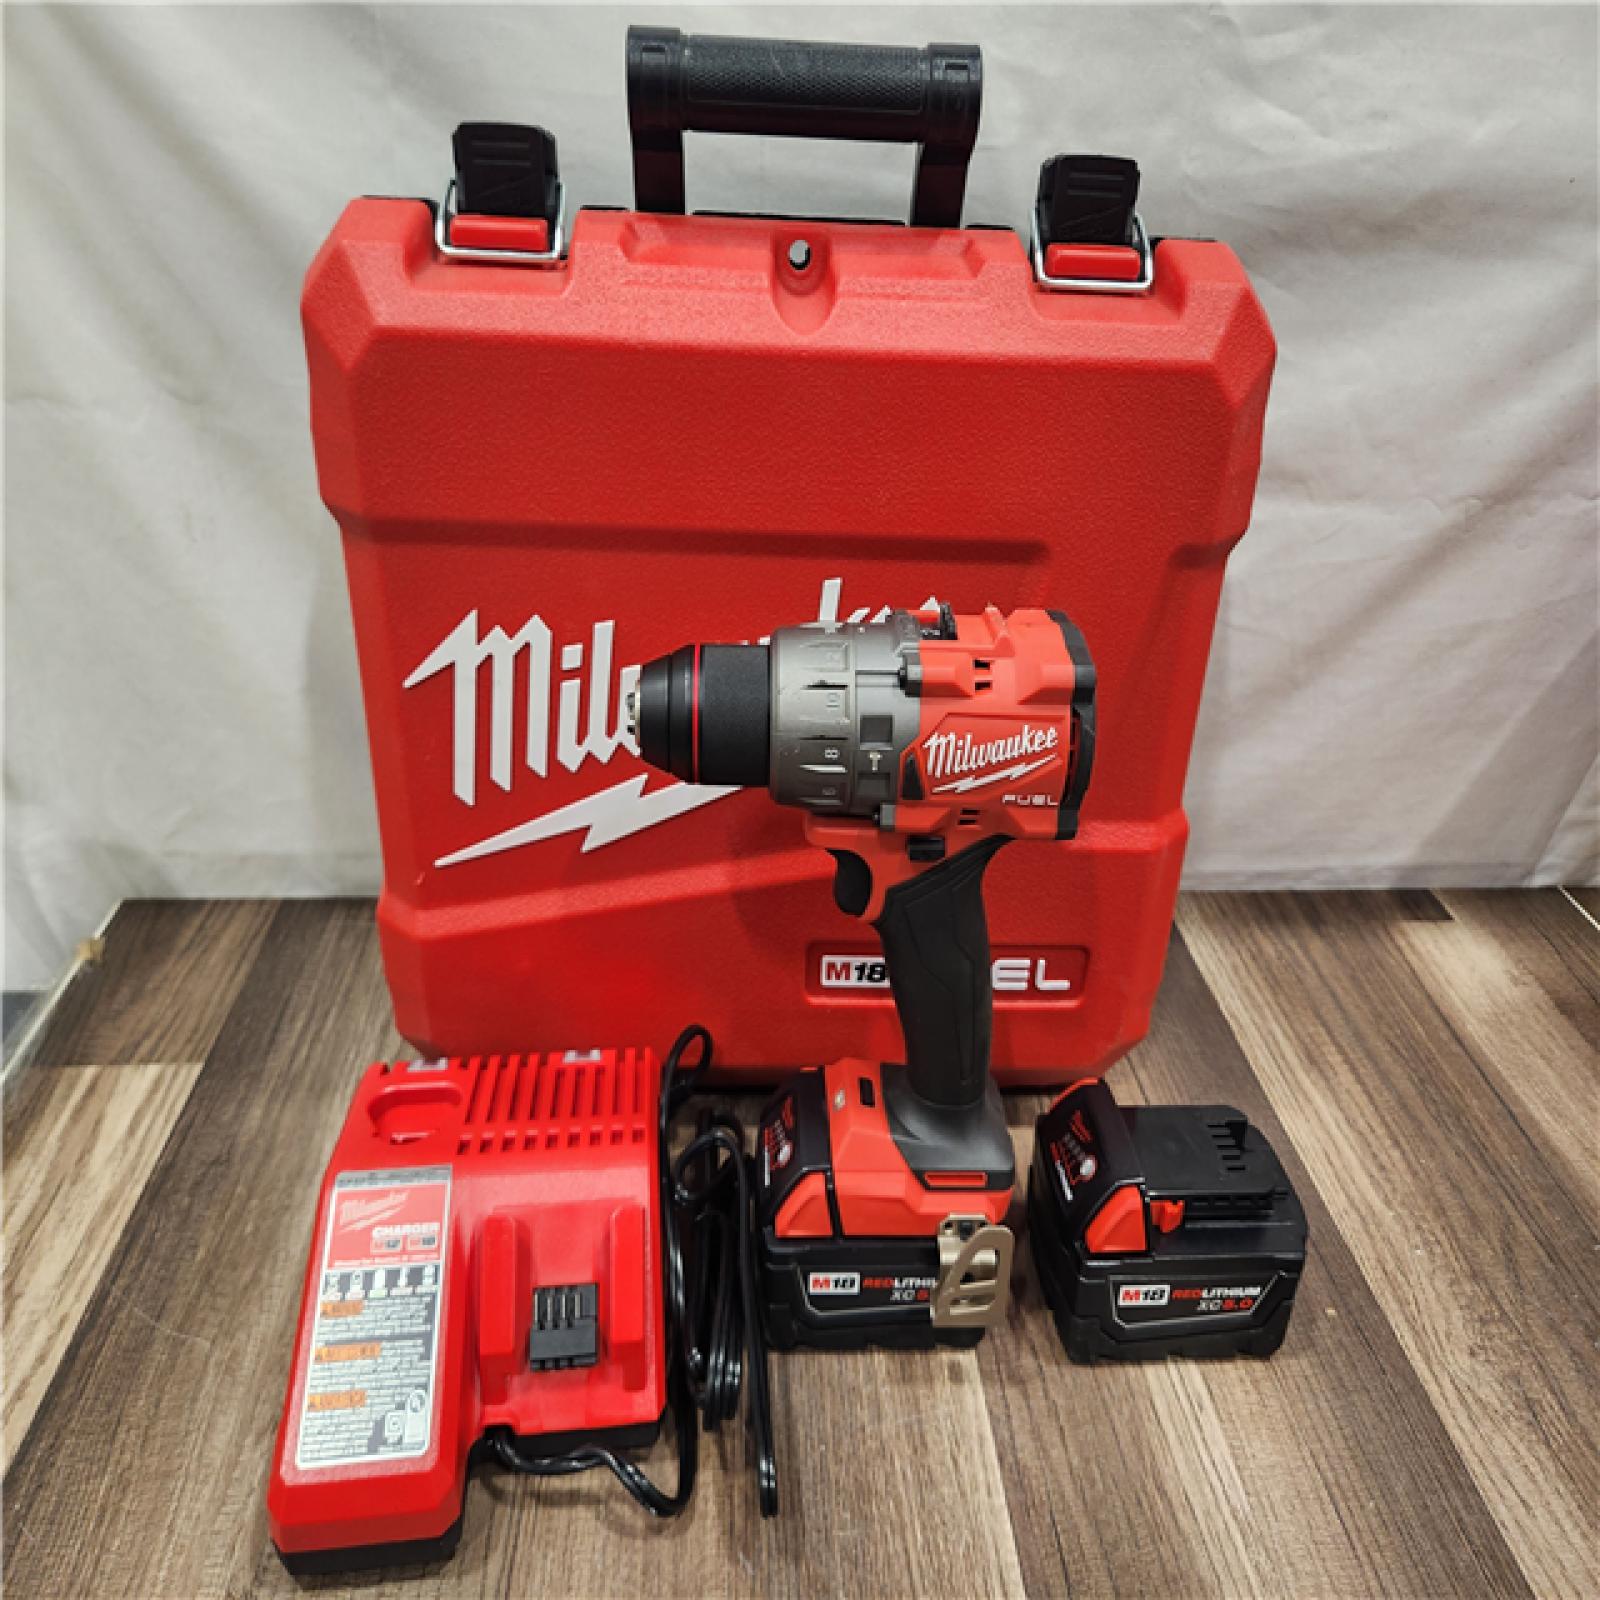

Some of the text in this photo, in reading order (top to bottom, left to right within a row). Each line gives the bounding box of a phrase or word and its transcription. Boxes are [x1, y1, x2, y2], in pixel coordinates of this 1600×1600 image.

[923, 724, 1058, 779] Milwaukee
[1003, 794, 1059, 806] FUEL
[827, 959, 1071, 990] M18 EL
[811, 1276, 857, 1290] M18
[1121, 1288, 1166, 1302] M18
